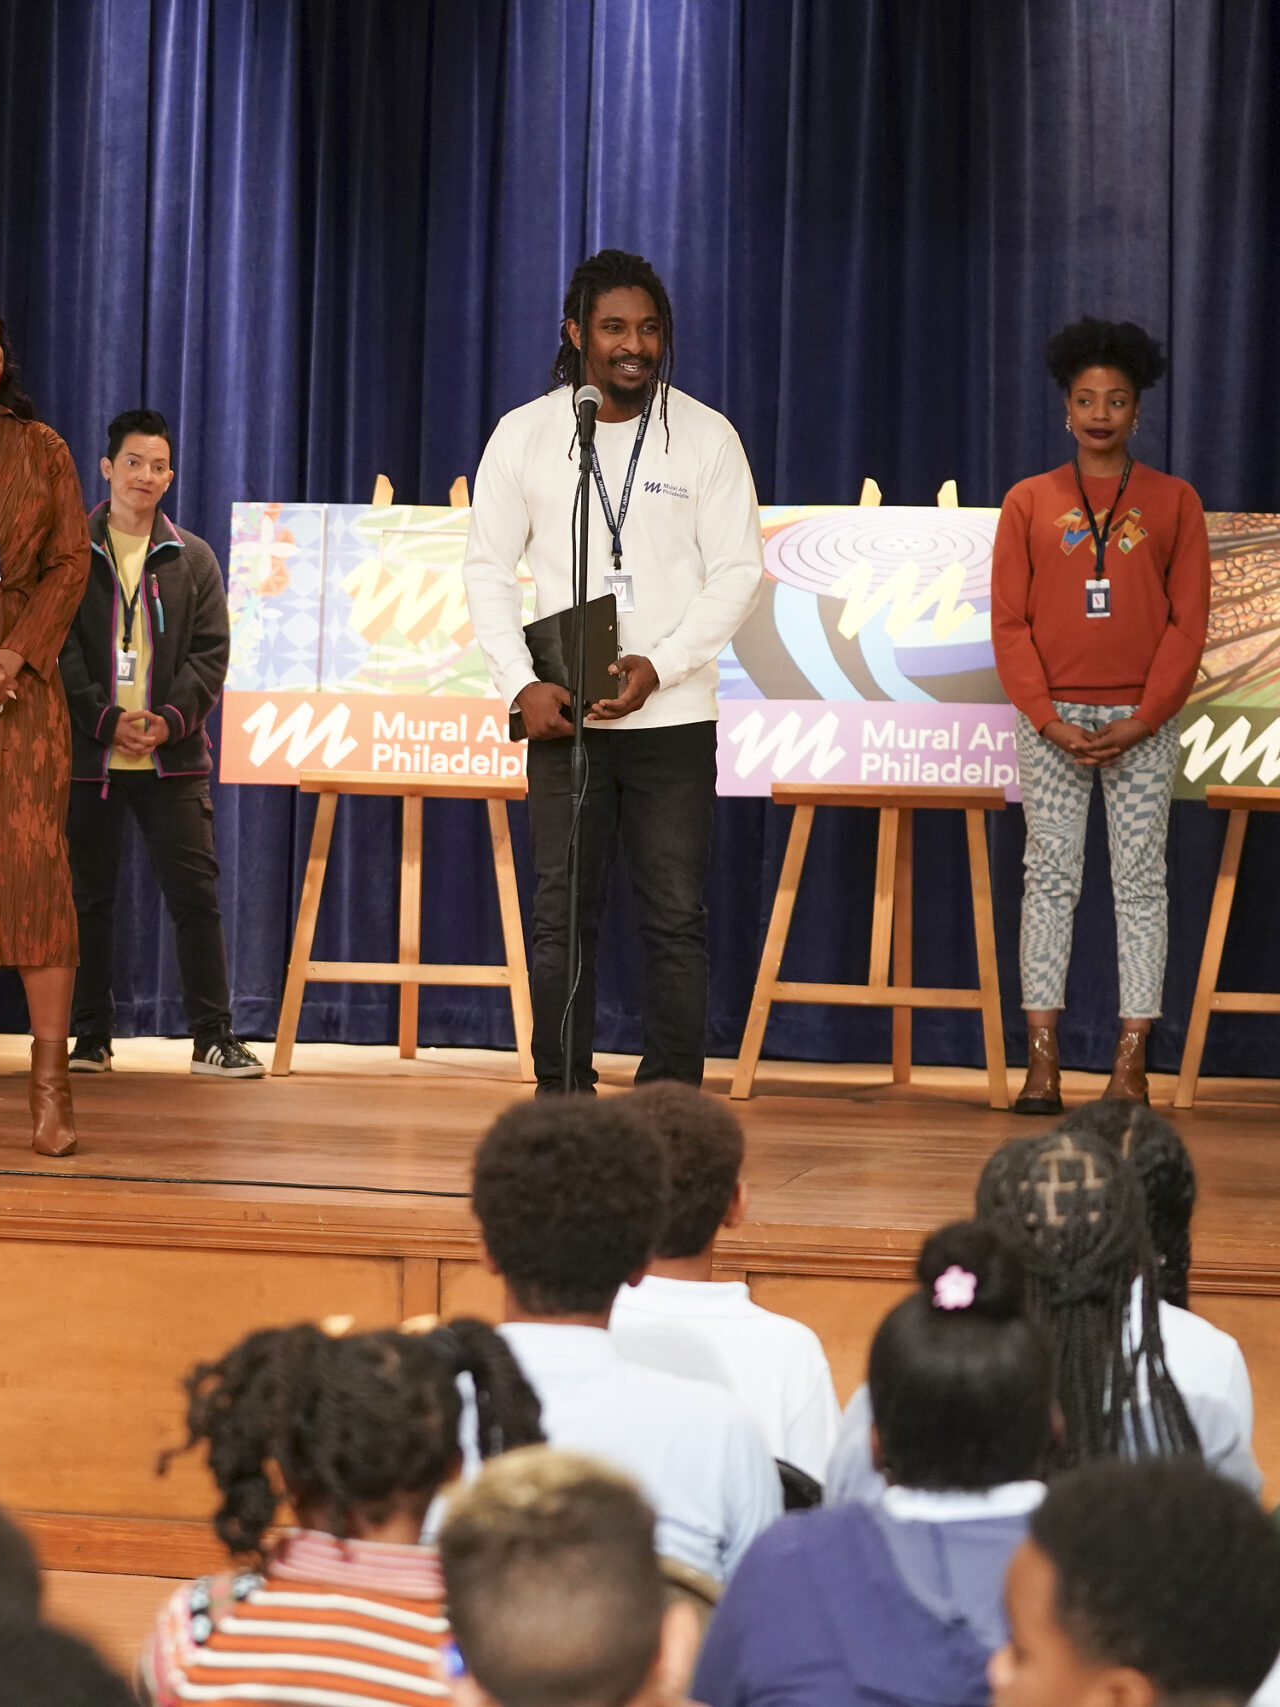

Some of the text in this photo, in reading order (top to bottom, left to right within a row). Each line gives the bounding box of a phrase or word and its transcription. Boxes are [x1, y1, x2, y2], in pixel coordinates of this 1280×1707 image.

[372, 711, 467, 742] Mural
[861, 719, 960, 750] Mural
[860, 753, 1020, 788] Philadelp
